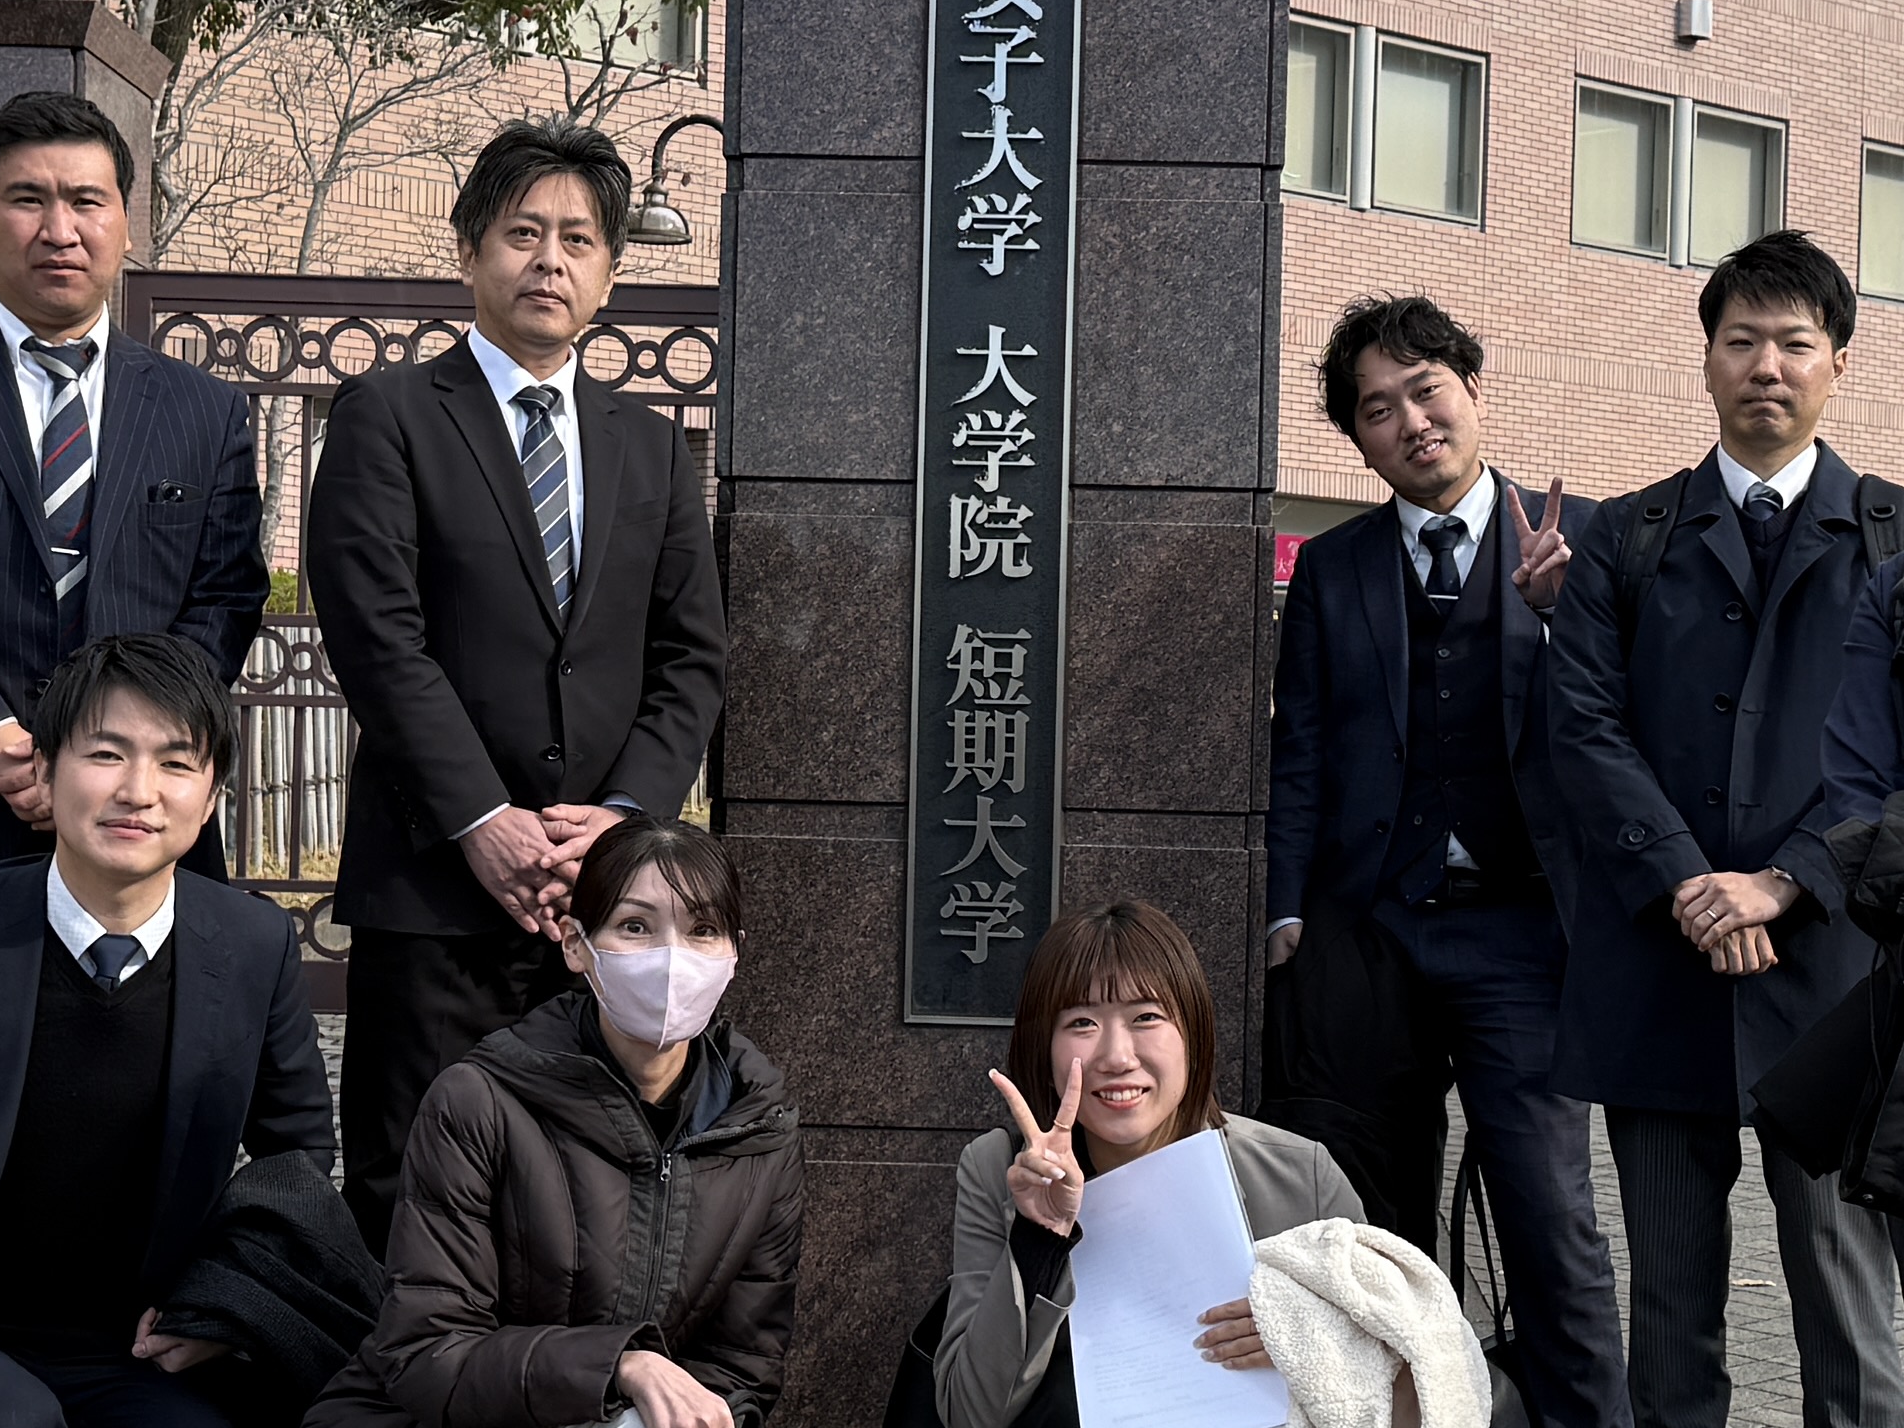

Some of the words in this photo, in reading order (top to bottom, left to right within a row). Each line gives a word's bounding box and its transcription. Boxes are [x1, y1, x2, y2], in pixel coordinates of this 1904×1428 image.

[947, 323, 1040, 580] 大学院
[939, 622, 1033, 965] 短期大学
